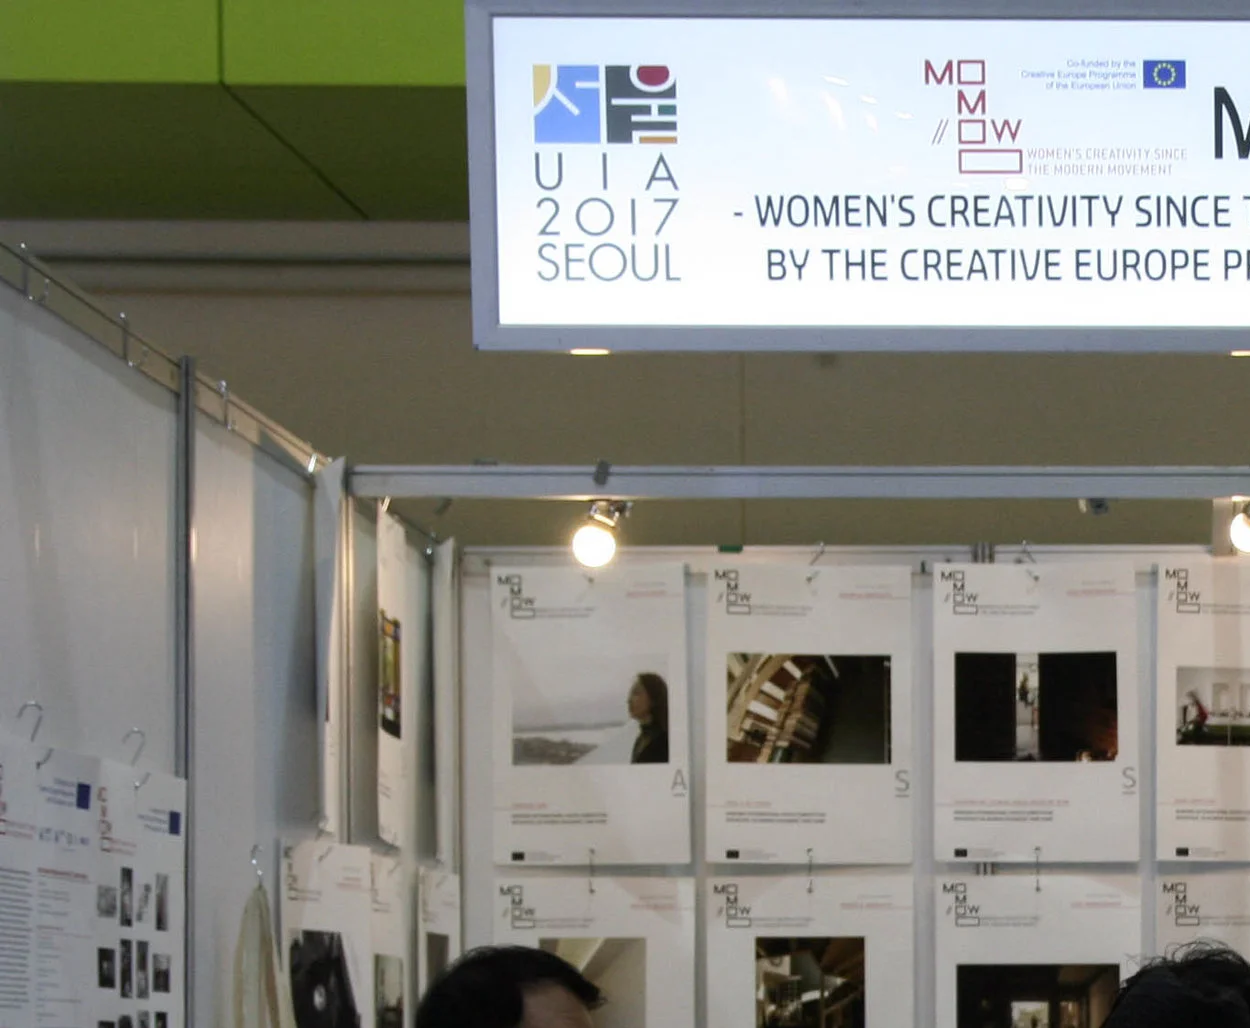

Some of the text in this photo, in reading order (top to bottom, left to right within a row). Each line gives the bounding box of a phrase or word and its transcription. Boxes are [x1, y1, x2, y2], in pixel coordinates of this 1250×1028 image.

[1123, 59, 1136, 68] the
[1057, 70, 1086, 80] Europe
[1089, 70, 1136, 80] Programme
[1055, 81, 1069, 90] the
[1071, 81, 1110, 90] European
[1112, 81, 1136, 90] Union
[1027, 147, 1187, 161] WOMEN'S CREATIVITY SINCE
[1028, 163, 1173, 176] THE MODERN MOVEMENT
[536, 197, 680, 236] 2017
[754, 194, 915, 228] WOMEN'S
[927, 194, 1123, 228] CREATIVITY
[1135, 194, 1231, 229] SINCE
[537, 242, 681, 282] SEOUL
[767, 248, 810, 281] BY
[821, 248, 888, 281] THE
[900, 248, 1062, 281] CREATIVE
[1075, 248, 1211, 282] EUROPE
